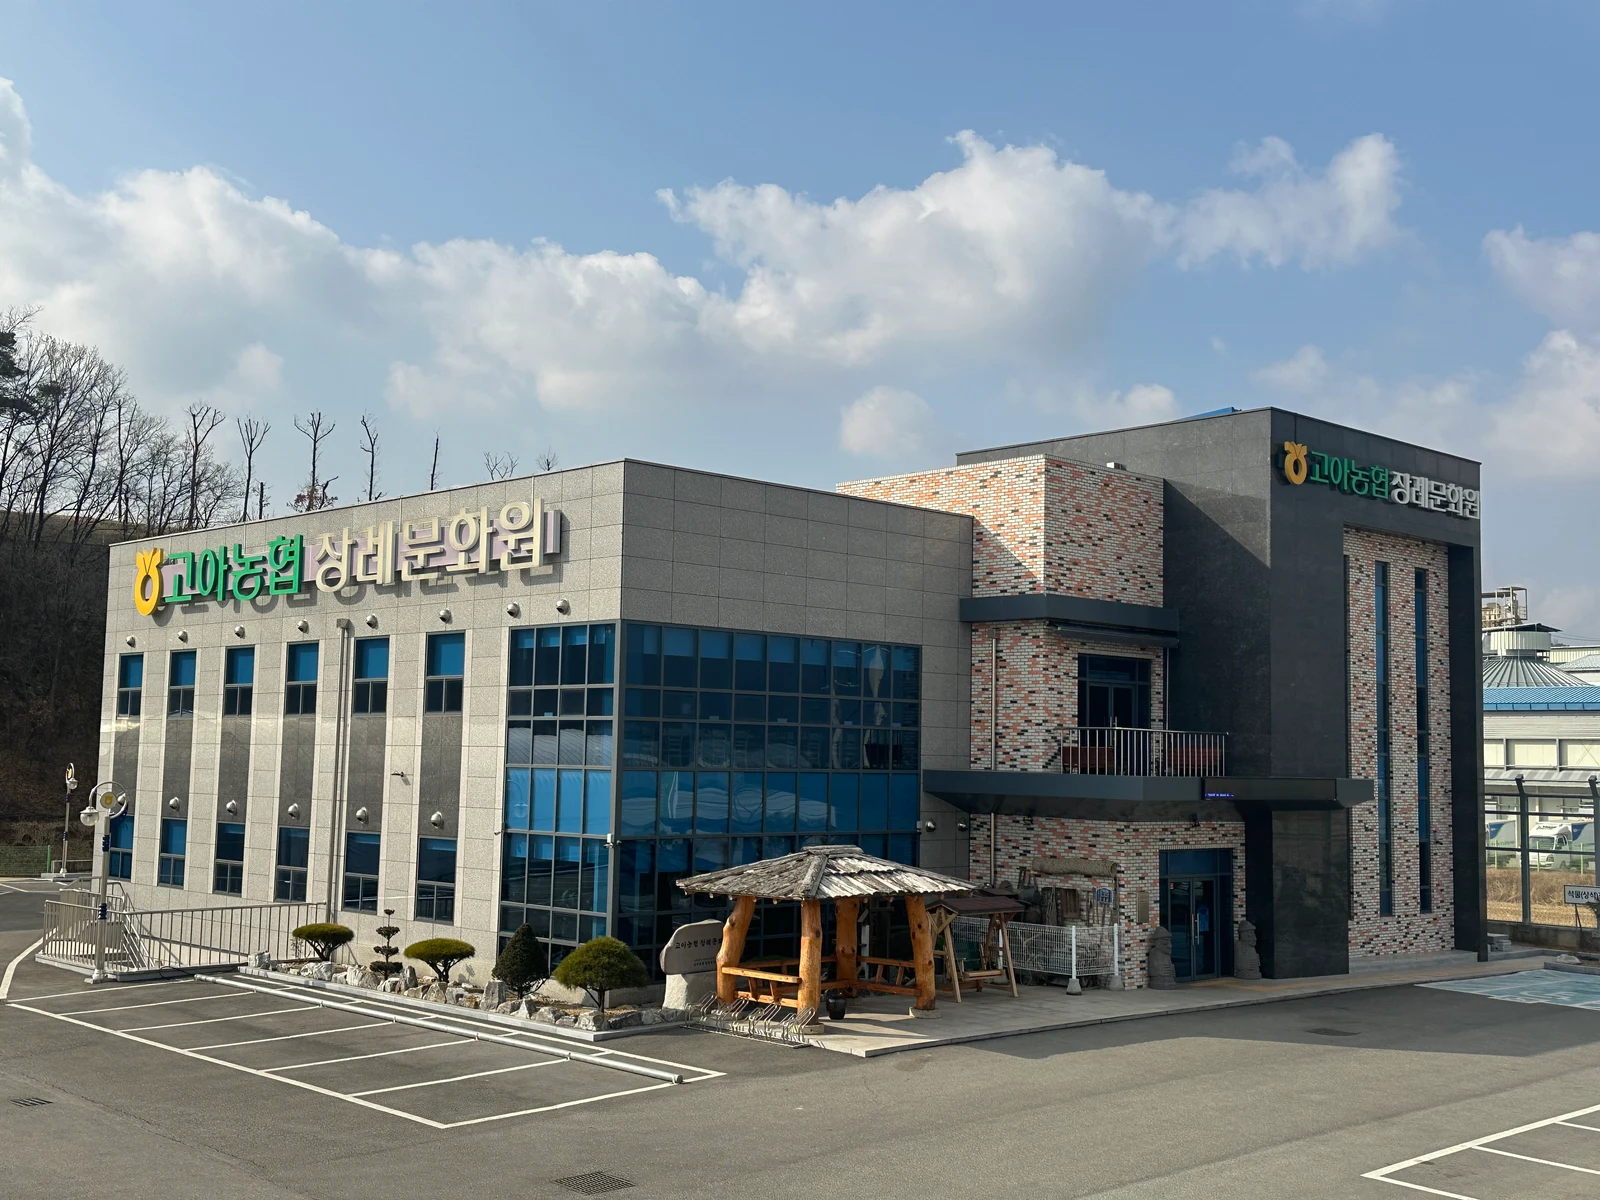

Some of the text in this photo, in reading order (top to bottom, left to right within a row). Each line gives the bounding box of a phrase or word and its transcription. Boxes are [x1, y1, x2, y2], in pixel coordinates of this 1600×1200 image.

[1311, 451, 1480, 520] 고아농협 장례문화원
[165, 497, 544, 603] 고아농협 장례문화원
